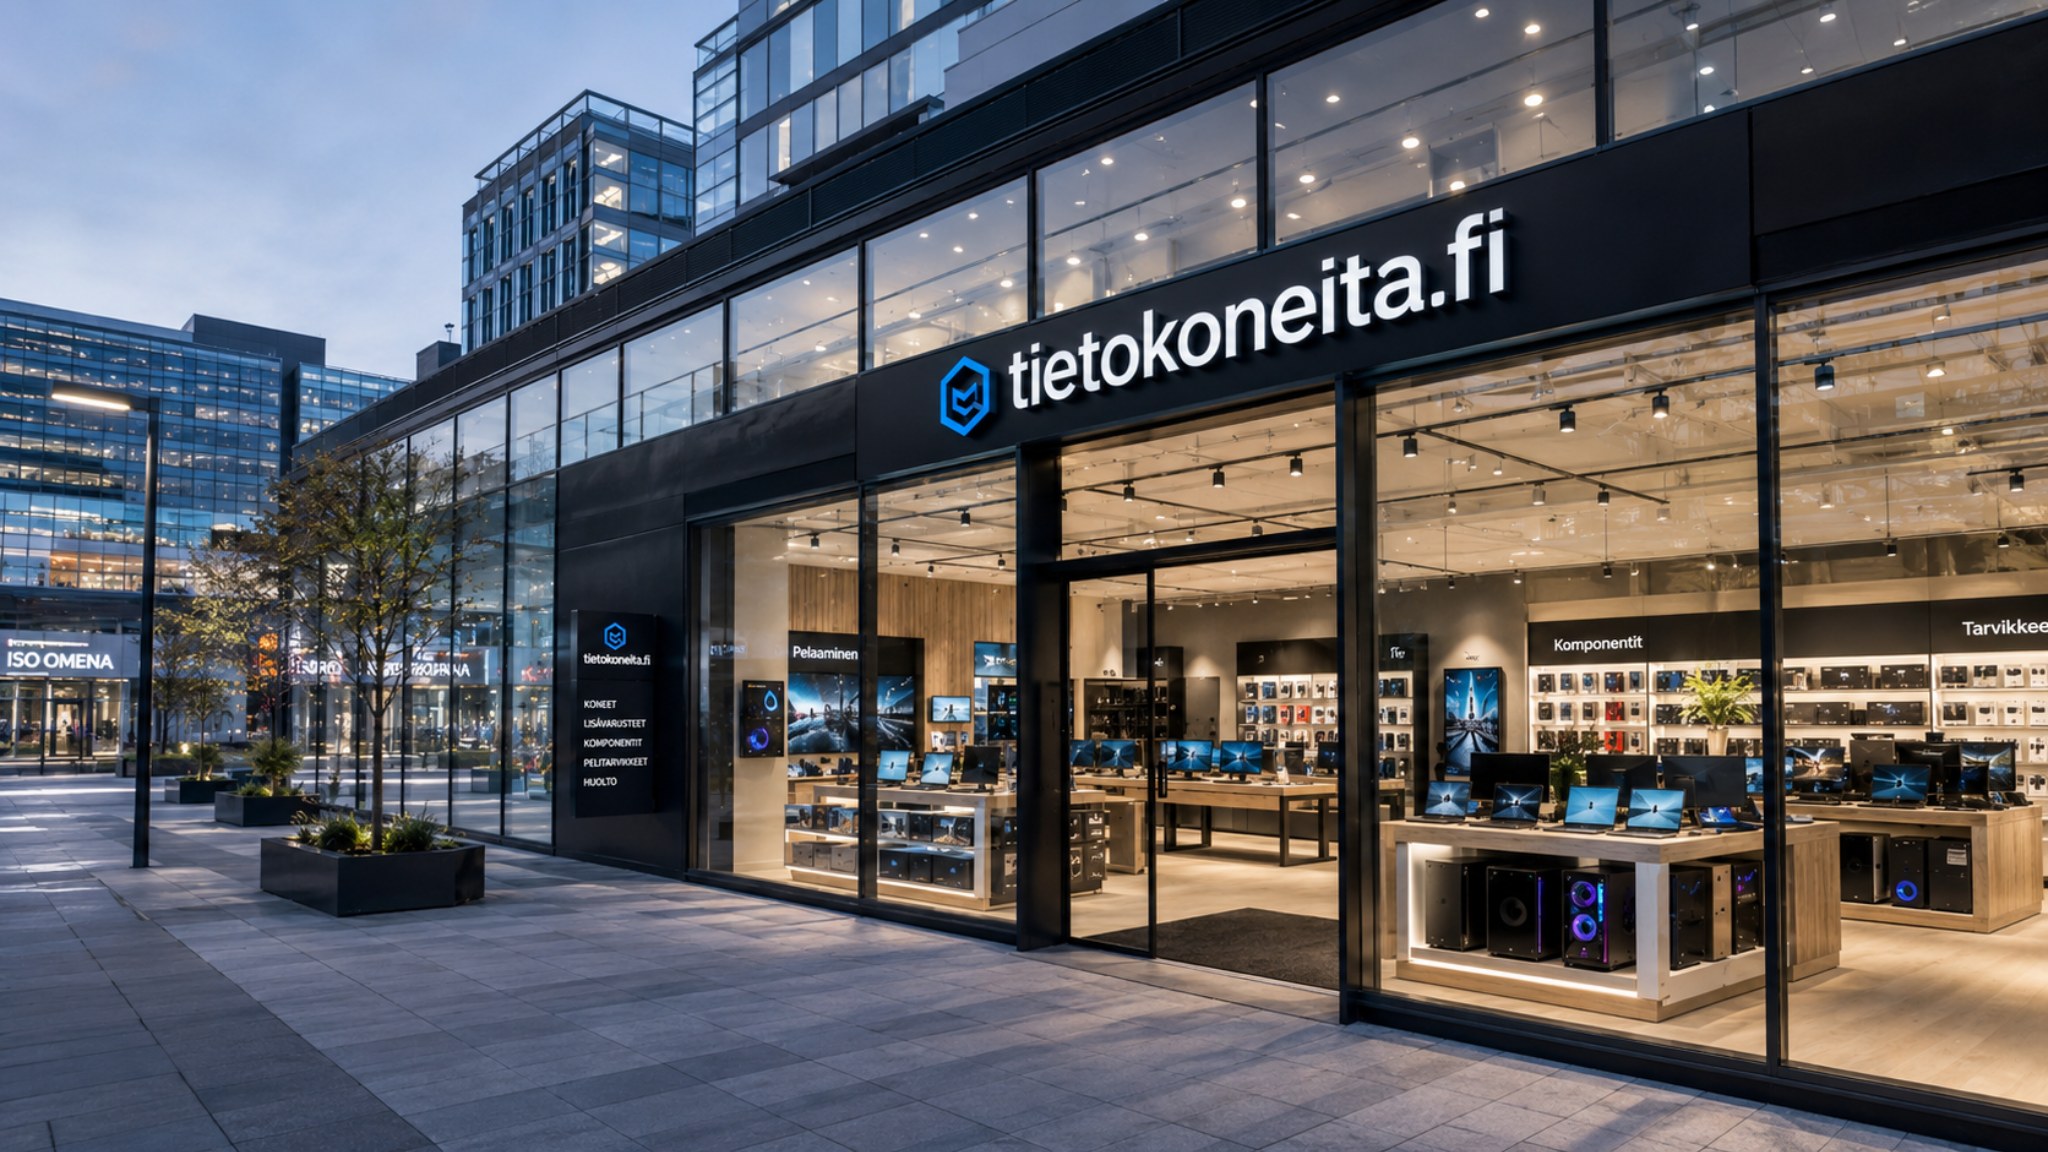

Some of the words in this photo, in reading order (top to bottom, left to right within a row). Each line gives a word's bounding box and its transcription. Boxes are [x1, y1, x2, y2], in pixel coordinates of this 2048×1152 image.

[1008, 207, 1505, 409] tietokoneita.fi
[1554, 635, 1643, 653] Komponentit
[584, 653, 651, 666] tietokoneita.fi
[793, 645, 859, 660] Pelaaminen
[7, 651, 40, 669] ISO
[43, 652, 114, 670] OMENA
[584, 700, 617, 709] KONEET
[584, 738, 643, 748] KOMPONENTIT
[584, 777, 618, 787] HUOLTO
